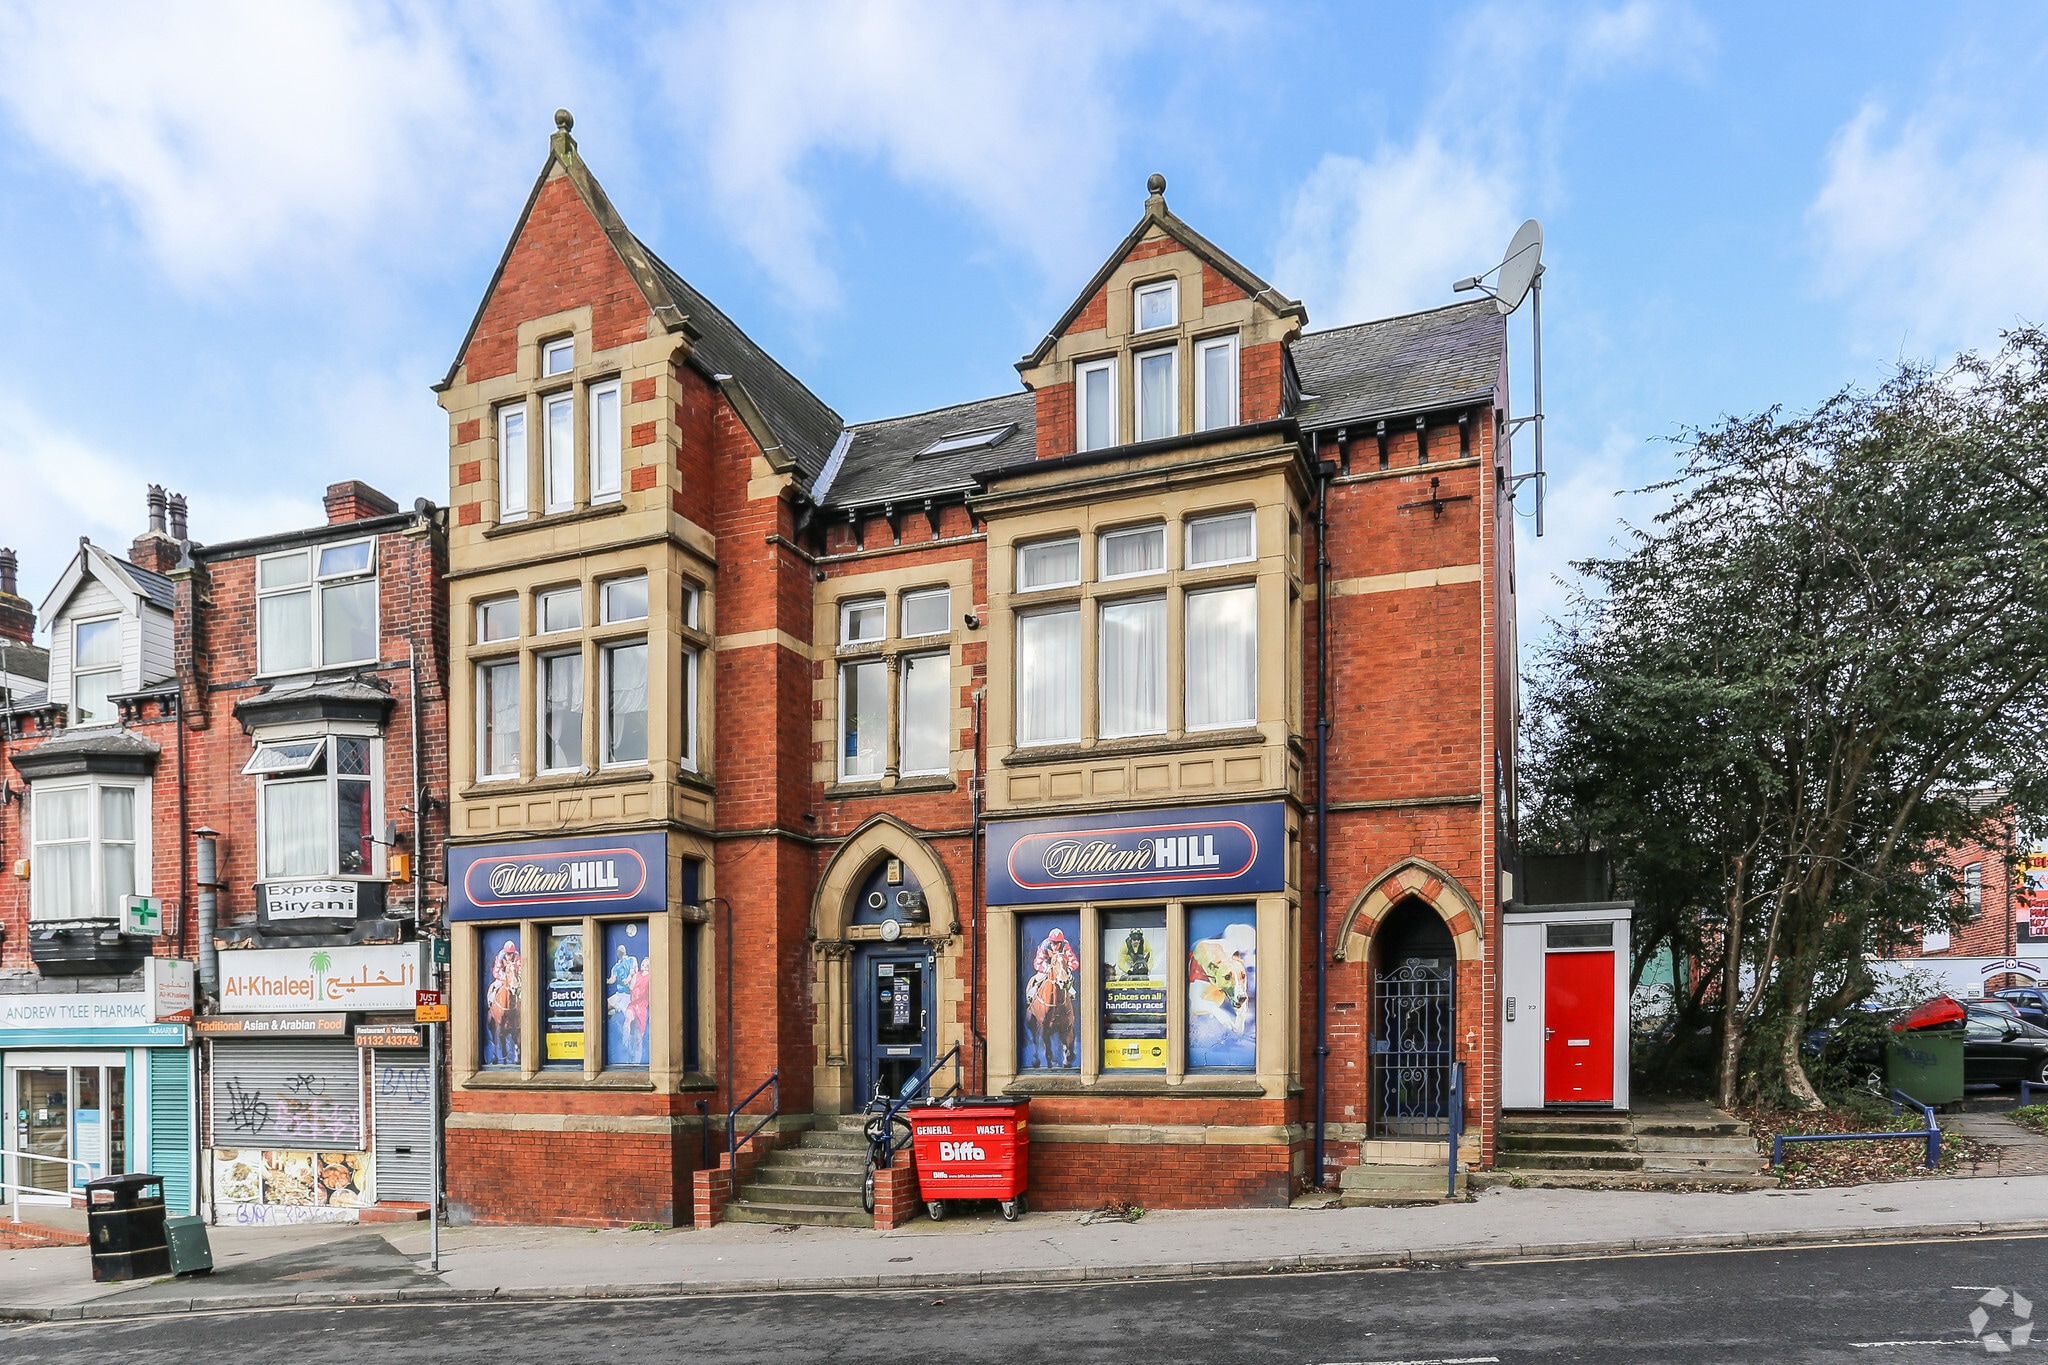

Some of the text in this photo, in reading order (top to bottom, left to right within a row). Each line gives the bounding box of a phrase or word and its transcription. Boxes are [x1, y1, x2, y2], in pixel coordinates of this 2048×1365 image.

[1041, 835, 1220, 878] William HILL
[489, 860, 619, 897] William HILL
[269, 884, 355, 896] Express
[269, 899, 354, 913] Biryani
[224, 974, 314, 1001] Al-Khaleej
[326, 962, 415, 1000] الخليج
[419, 992, 438, 1002] JUST
[552, 991, 570, 1000] Best
[1107, 993, 1114, 1001] 5
[1114, 993, 1139, 1002] places
[1151, 992, 1162, 1000] all
[6, 1005, 56, 1020] ANDREW
[59, 1004, 89, 1019] TYLEE
[1105, 1001, 1142, 1011] handicap
[195, 1018, 342, 1032] Traditional Asian & Arabian Food
[356, 1035, 419, 1046] 01132 433742
[916, 1125, 1005, 1135] GENERAL WASTE
[939, 1141, 986, 1162] Biffa
[932, 1171, 948, 1179] Biffa
